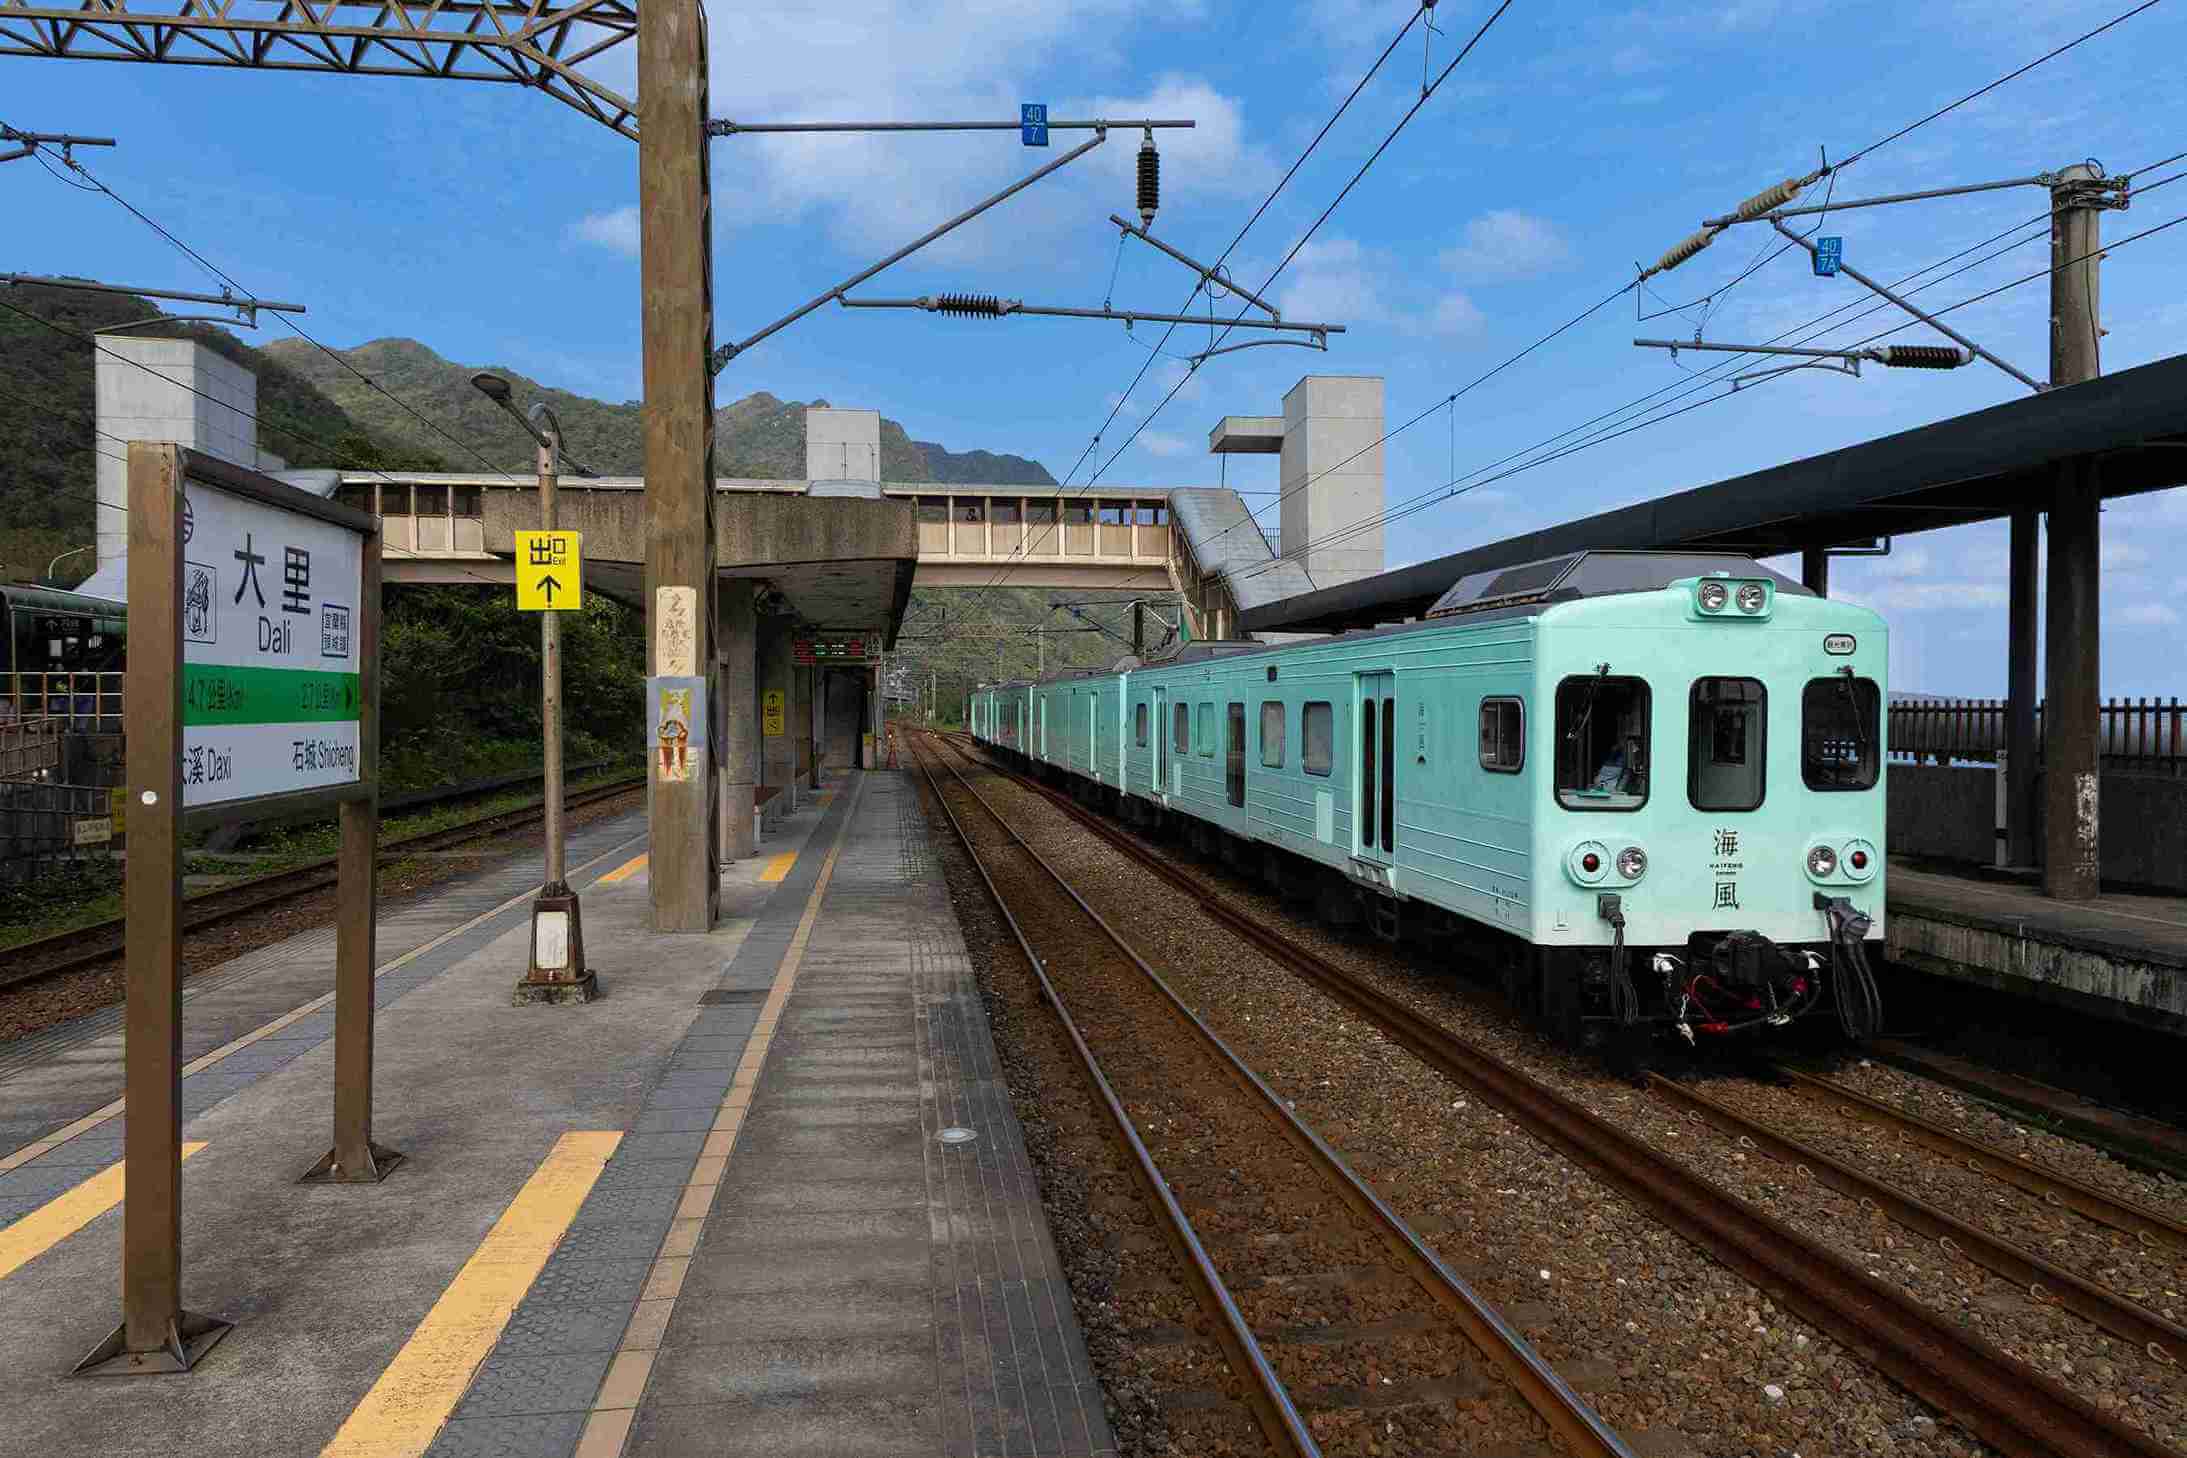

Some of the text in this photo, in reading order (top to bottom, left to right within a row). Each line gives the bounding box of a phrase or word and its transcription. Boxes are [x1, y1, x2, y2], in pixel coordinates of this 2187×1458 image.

[530, 537, 566, 565] 出口
[234, 532, 311, 615] 大里
[258, 616, 290, 654] Dali
[207, 747, 233, 782] Daxi
[292, 736, 317, 773] 石城
[1714, 829, 1738, 856] 海
[1712, 881, 1739, 910] 風
